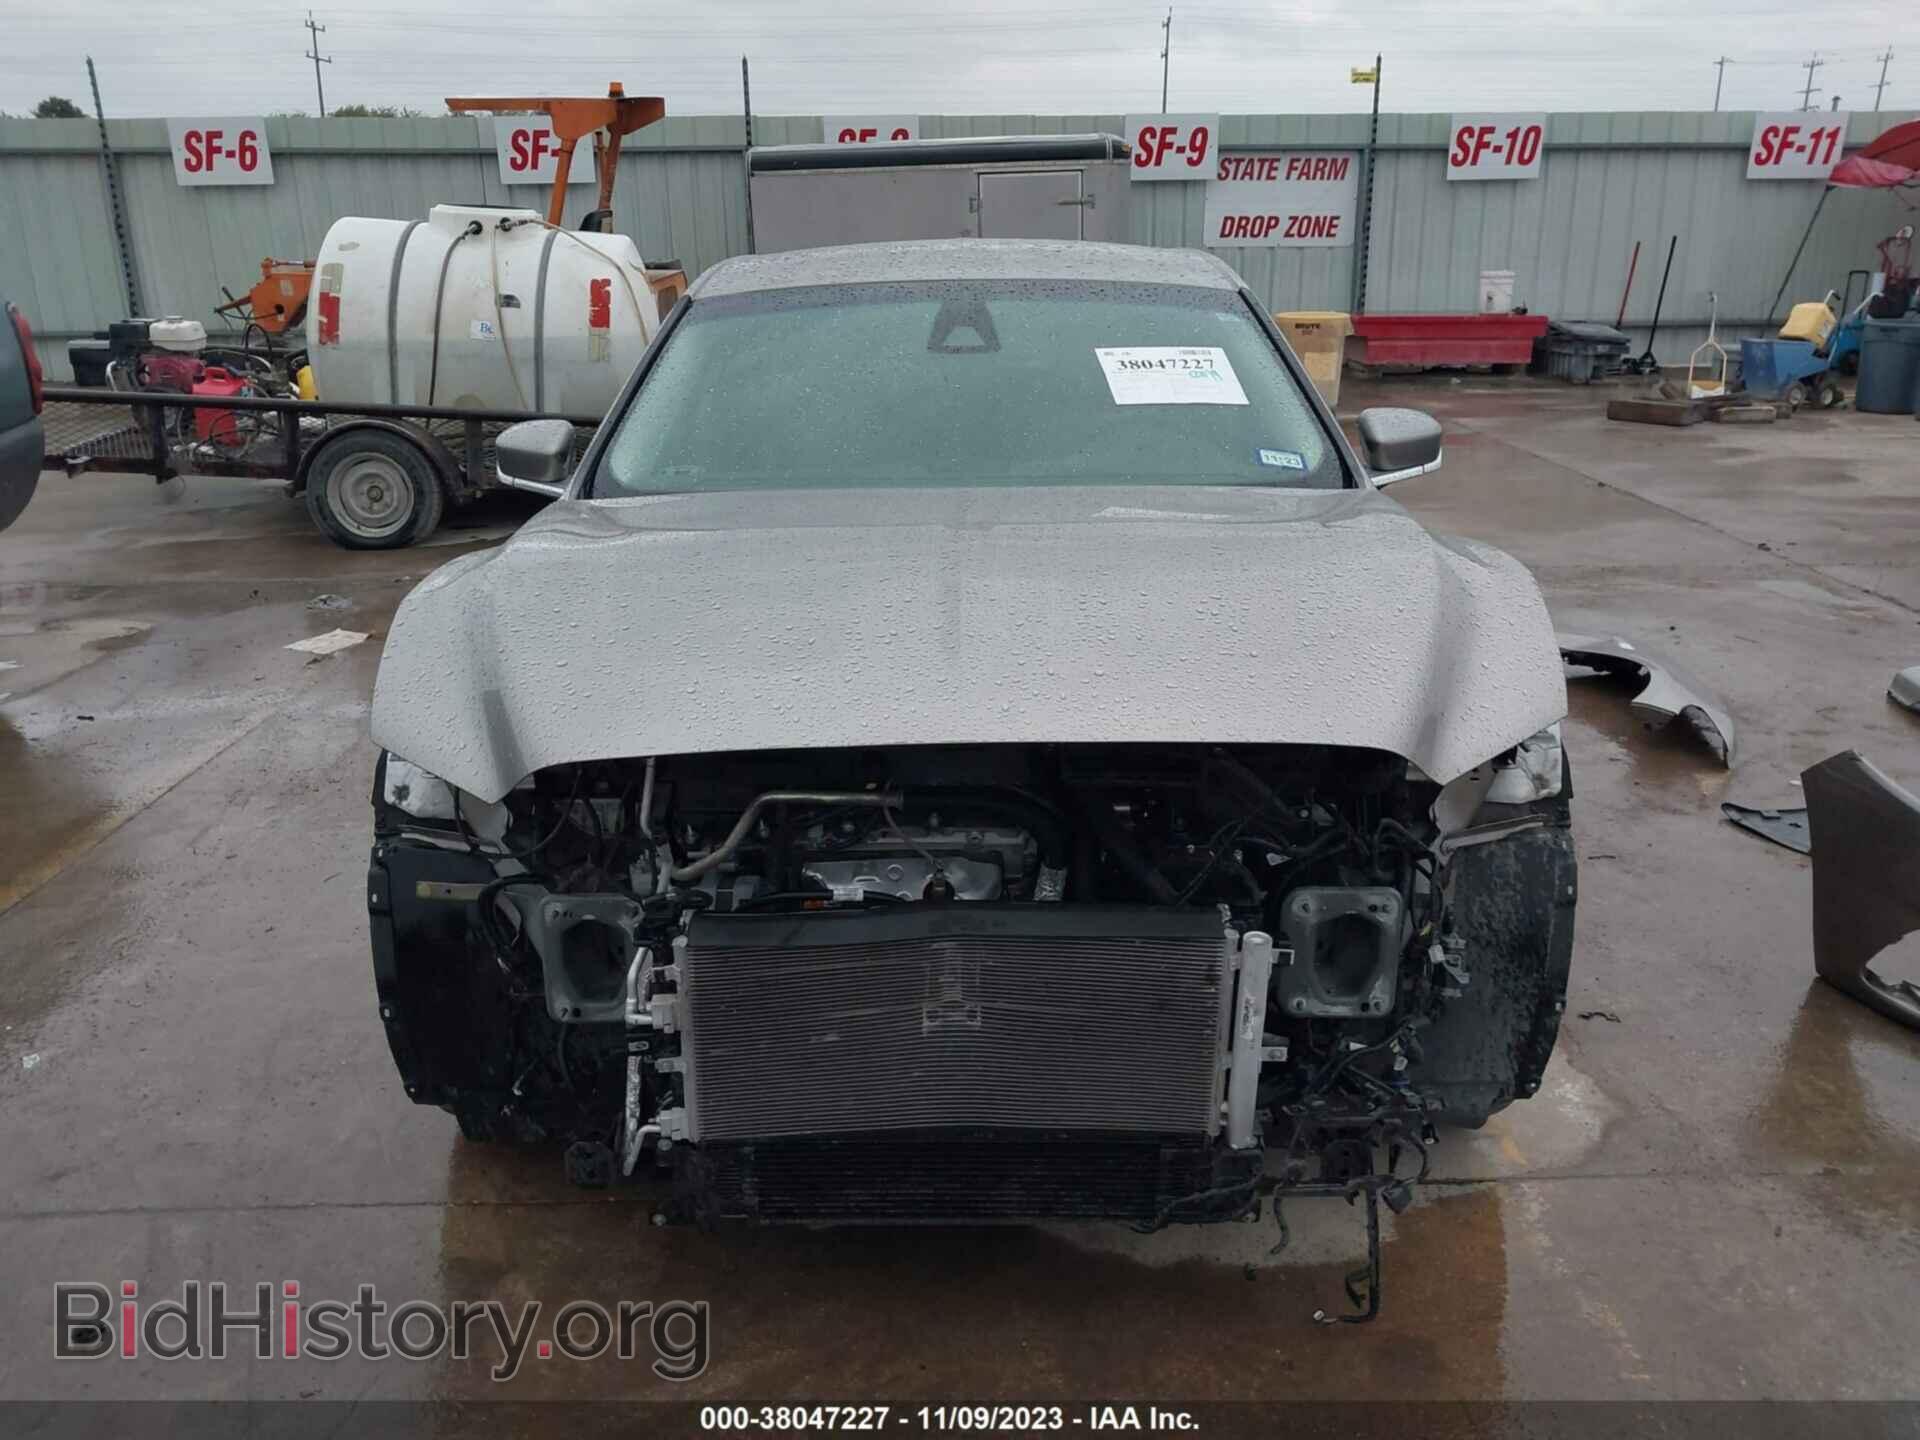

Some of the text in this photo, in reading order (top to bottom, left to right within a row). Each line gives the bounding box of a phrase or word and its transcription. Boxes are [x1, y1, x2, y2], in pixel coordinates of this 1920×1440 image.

[184, 130, 258, 172] SF-6
[510, 129, 561, 172] SF-
[1134, 126, 1209, 168] SF-9
[1451, 126, 1542, 168] SF-10
[1754, 126, 1841, 166] SF-11
[1217, 157, 1350, 181] STATE FARM
[1219, 215, 1341, 239] DROP ZONE
[1116, 359, 1214, 371] 38047227
